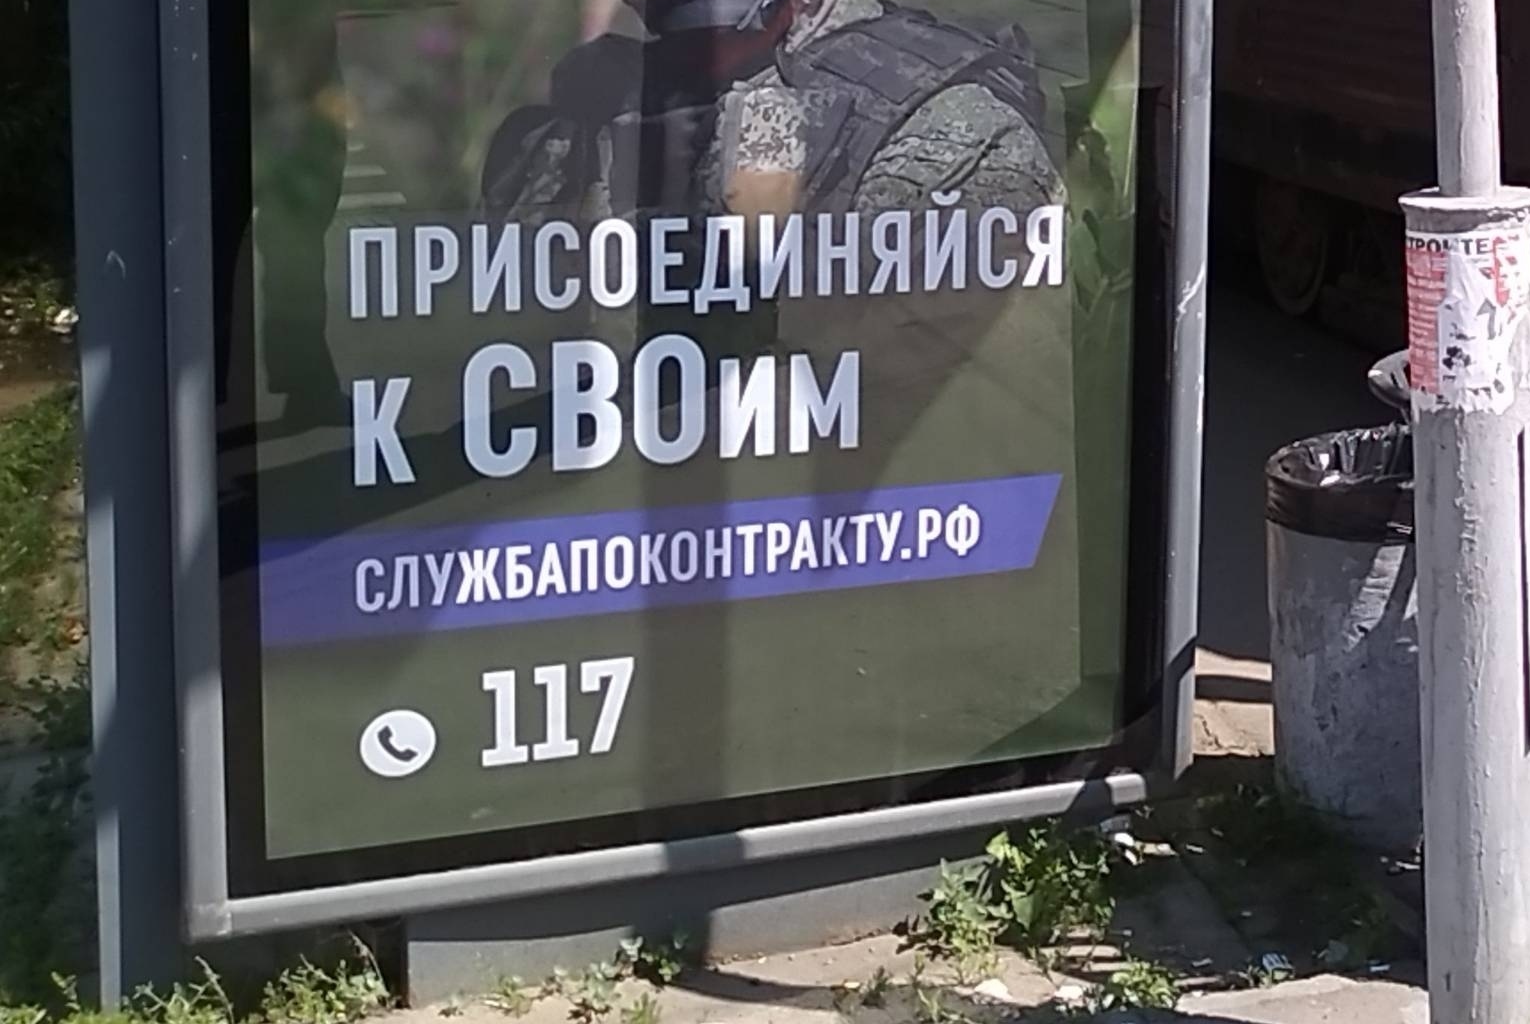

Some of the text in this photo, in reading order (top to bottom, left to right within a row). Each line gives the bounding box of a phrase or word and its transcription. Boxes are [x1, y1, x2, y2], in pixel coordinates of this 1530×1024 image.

[347, 191, 1066, 319] ПРИСОЕДИНЯЙСЯ
[352, 377, 417, 487] К
[354, 503, 983, 614] СЛУЖБАПОКОНТРАКТУ.РФ
[481, 656, 636, 768] 117
